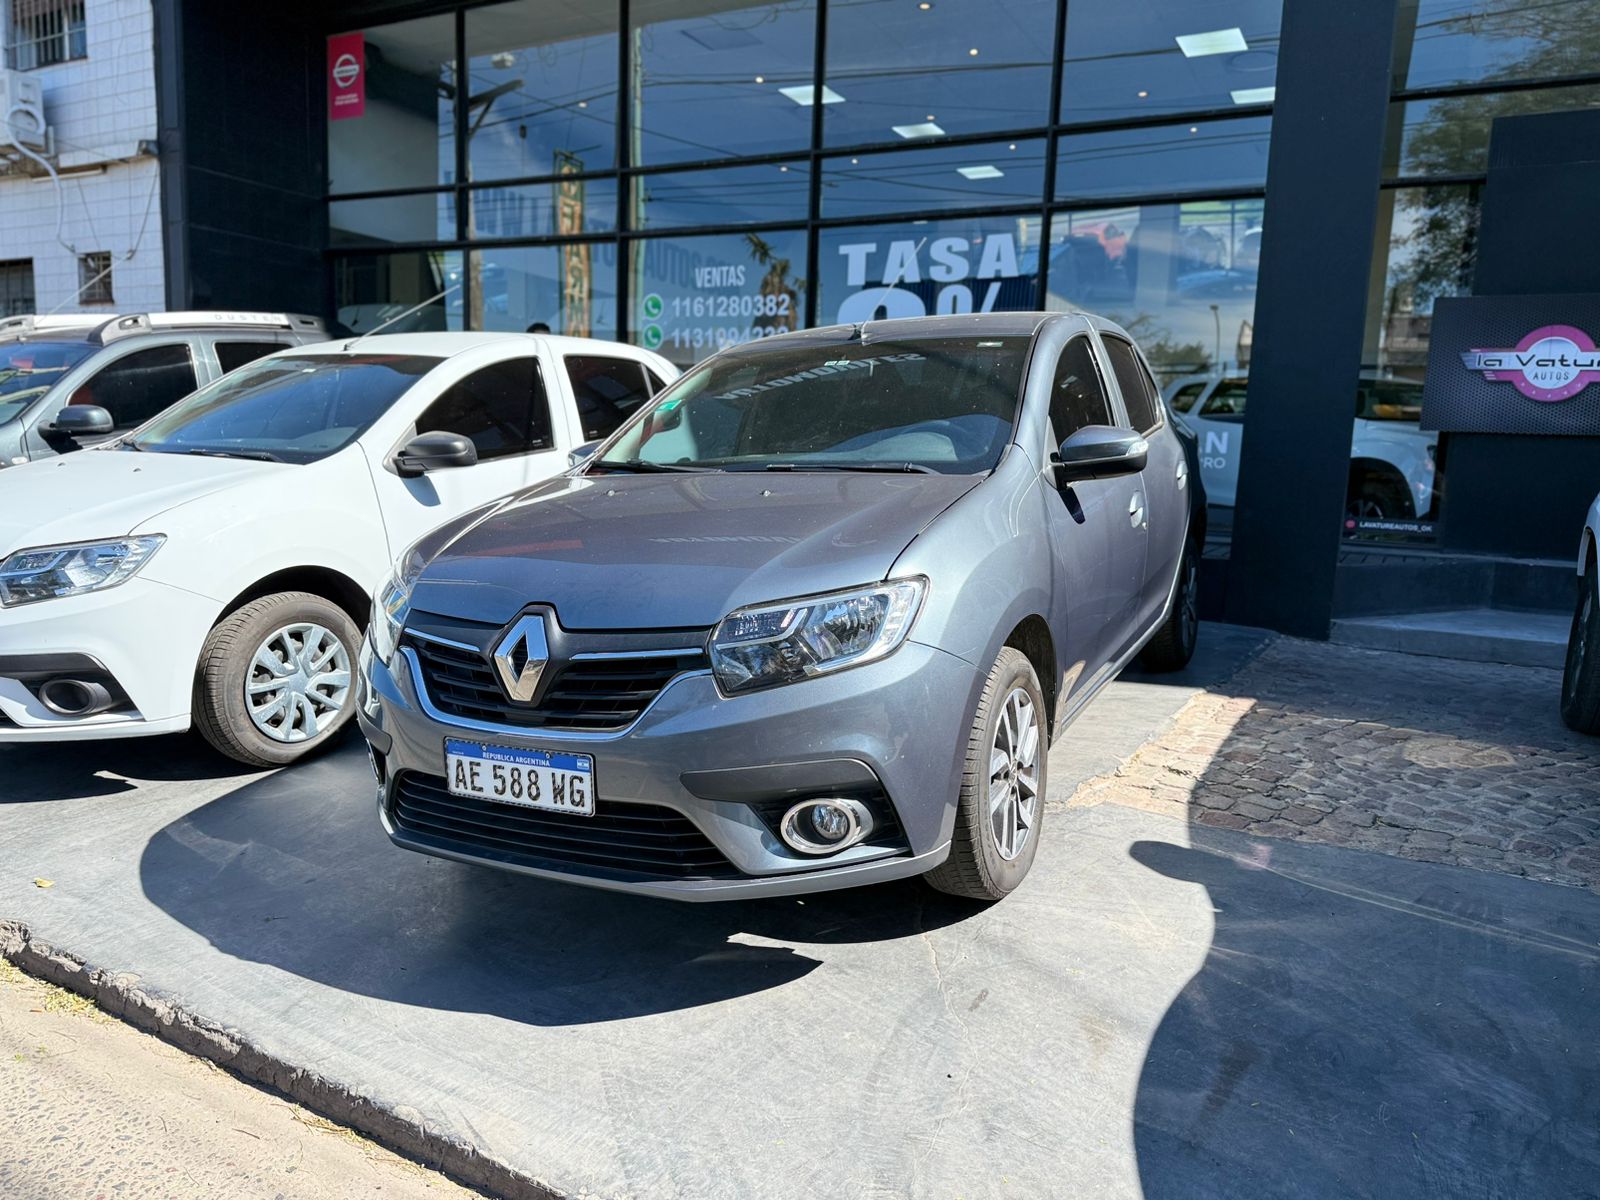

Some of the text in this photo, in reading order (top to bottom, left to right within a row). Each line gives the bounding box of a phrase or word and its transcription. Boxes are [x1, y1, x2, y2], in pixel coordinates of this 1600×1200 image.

[838, 233, 1019, 286] TASA
[695, 266, 745, 288] VENTAS
[671, 294, 790, 317] 1161280382
[1477, 354, 1502, 367] la
[1533, 371, 1569, 381] AUTOS
[1199, 431, 1228, 454] N
[1200, 457, 1226, 469] RO
[482, 751, 551, 767] REPUBLICA ARGENTINA
[455, 758, 585, 808] AE 588 WG
